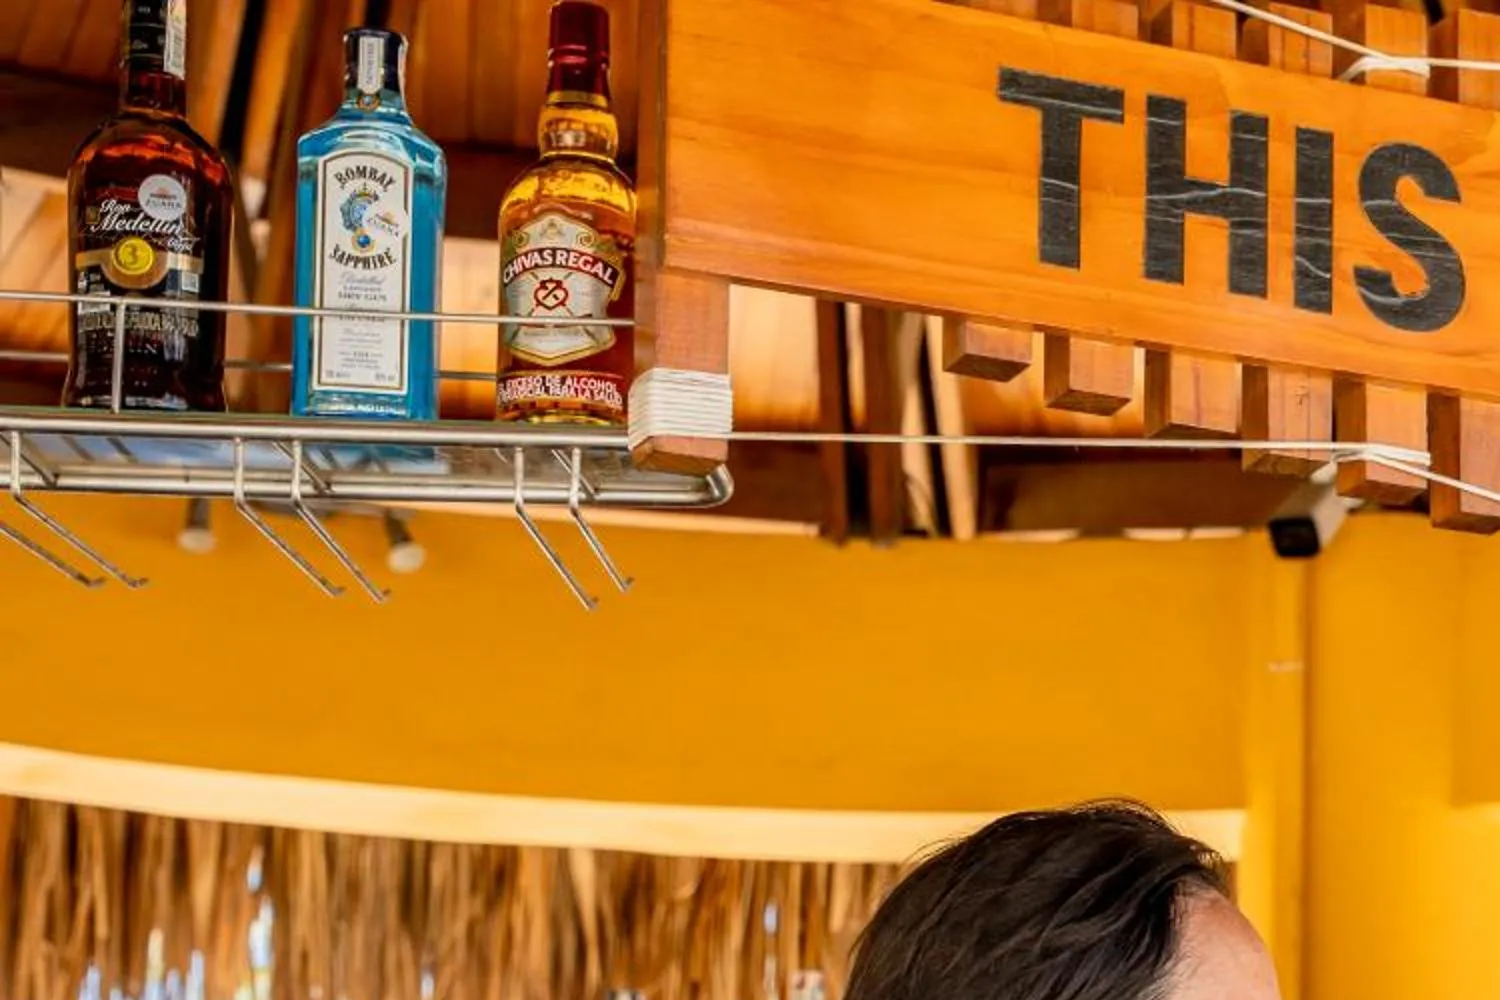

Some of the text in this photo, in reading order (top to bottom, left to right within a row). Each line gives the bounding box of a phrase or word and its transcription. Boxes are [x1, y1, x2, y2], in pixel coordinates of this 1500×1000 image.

[334, 165, 395, 191] BOMBAY
[100, 199, 132, 214] Ron
[998, 67, 1465, 331] THIS
[329, 244, 396, 270] SAPPHIRE
[503, 249, 615, 286] CHIVAS REGAL
[564, 376, 617, 393] ALCOHOL
